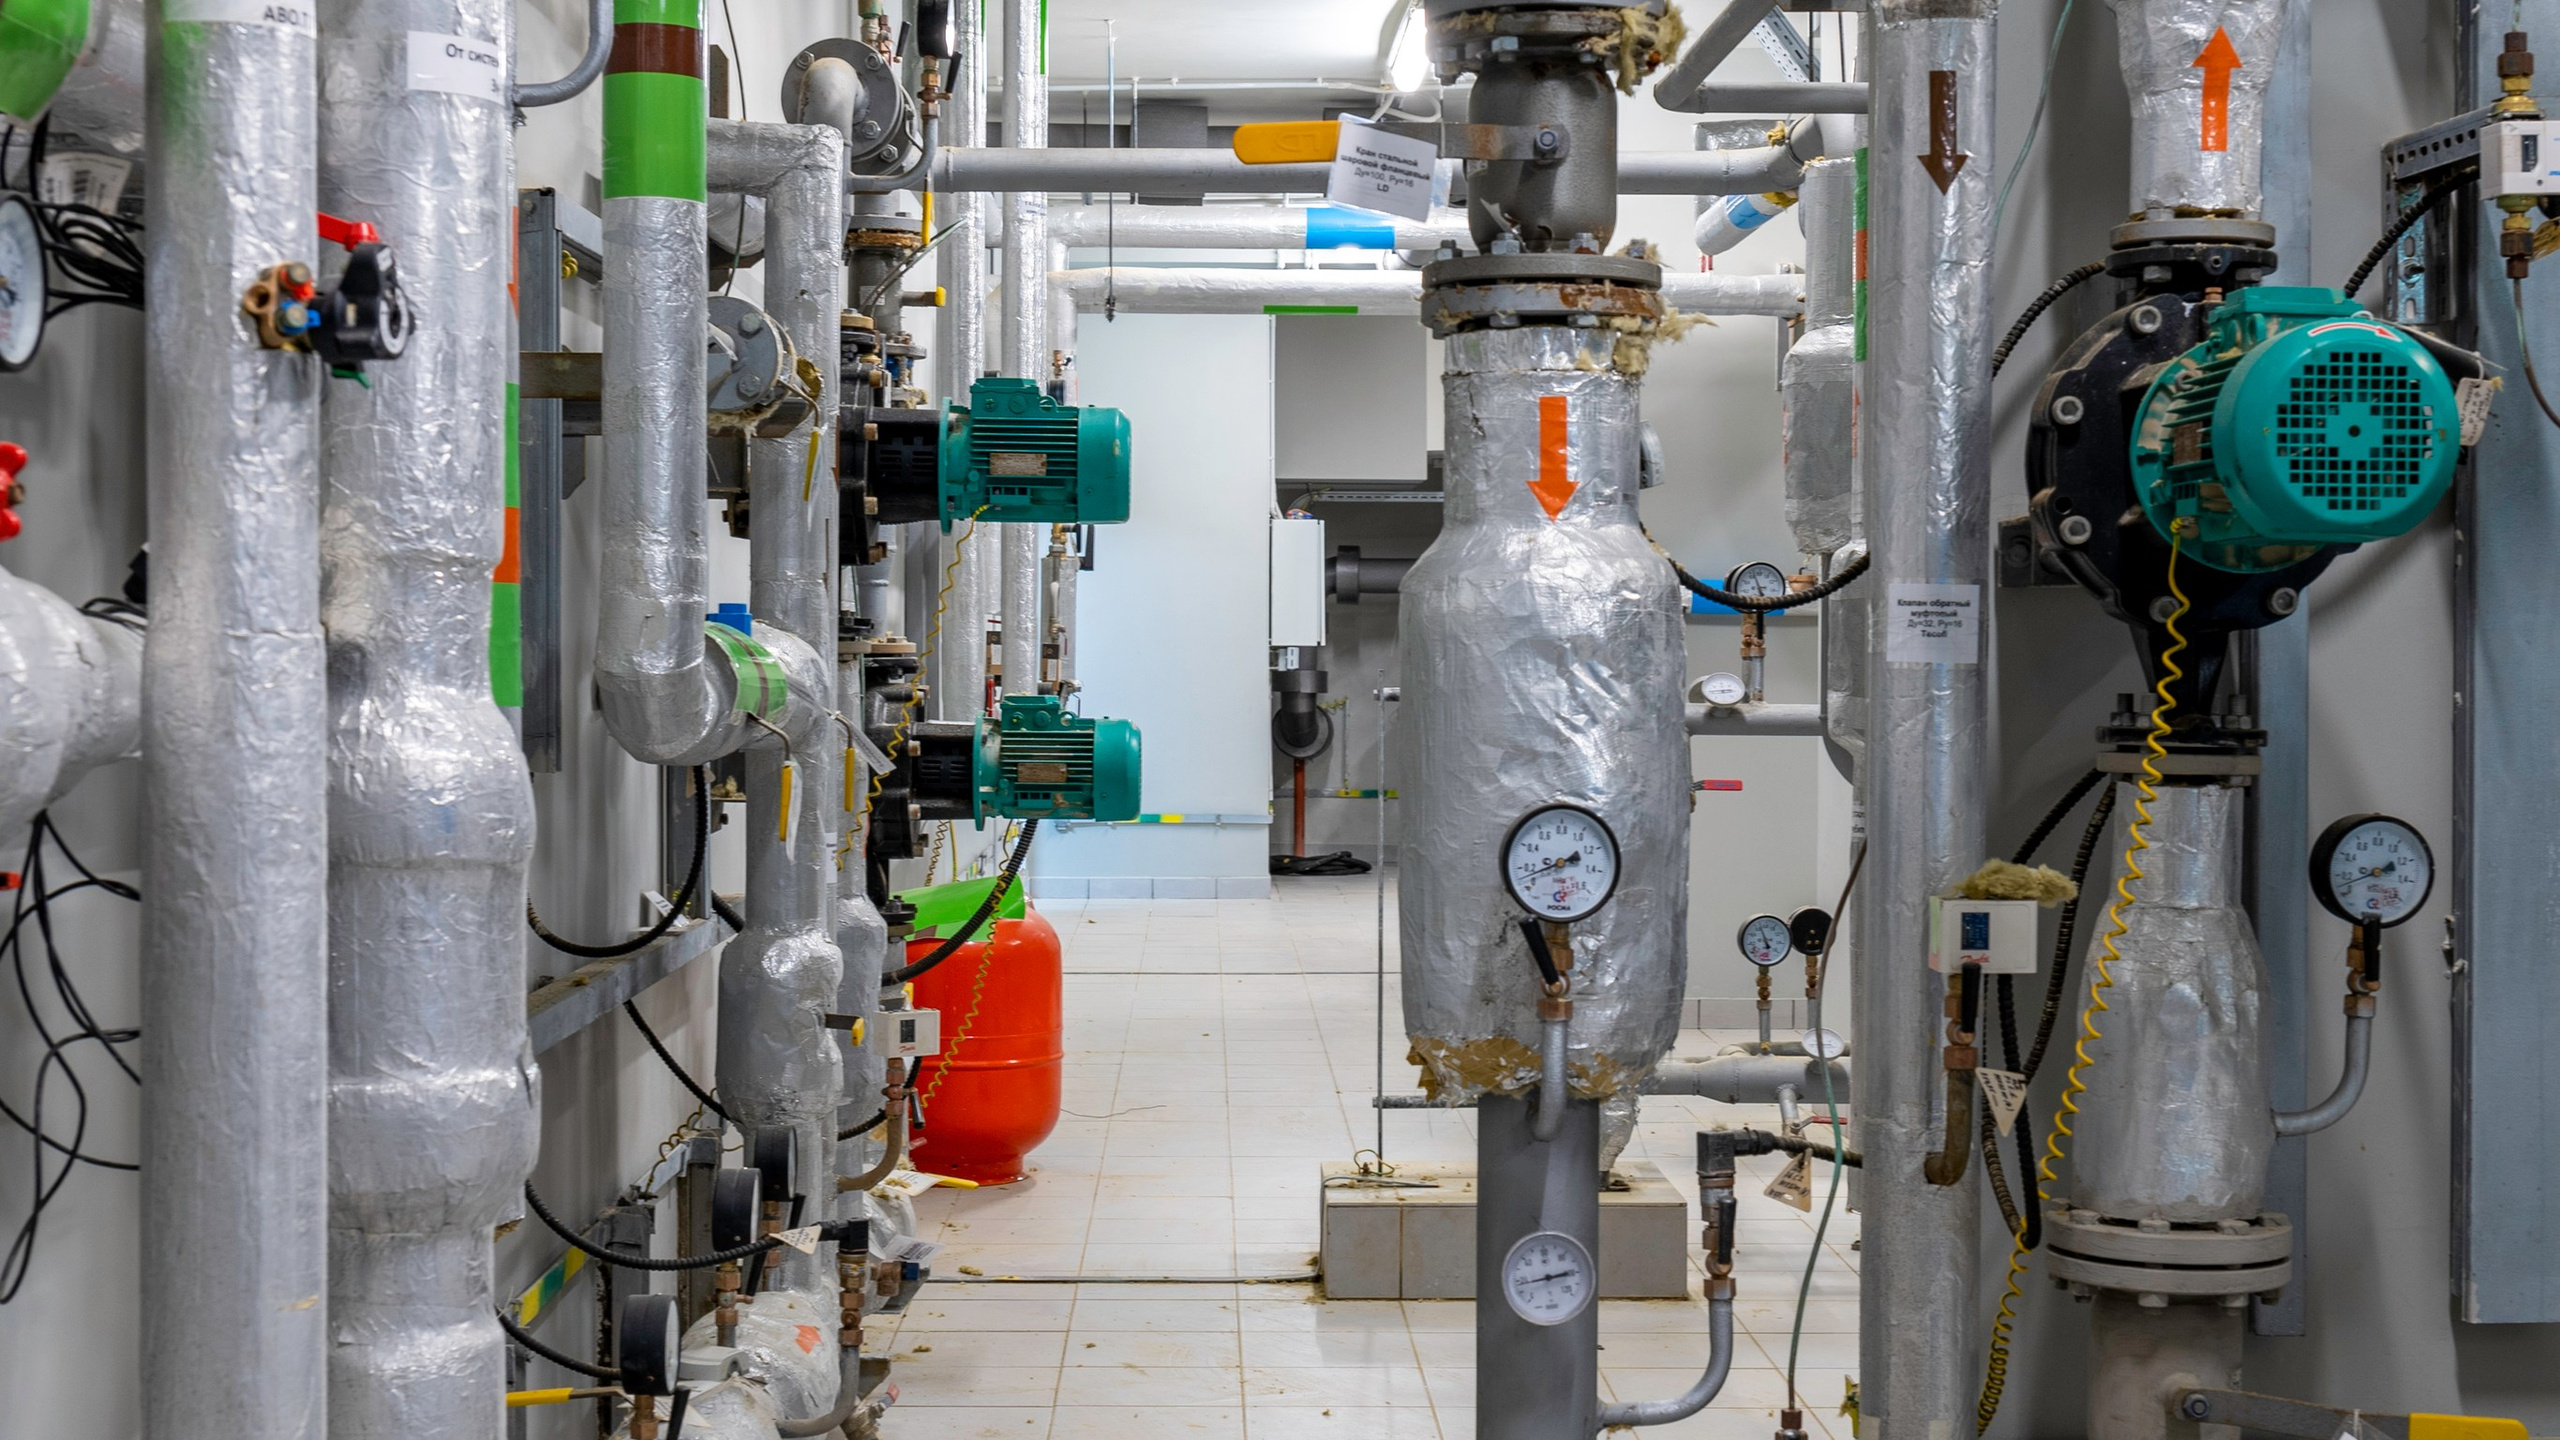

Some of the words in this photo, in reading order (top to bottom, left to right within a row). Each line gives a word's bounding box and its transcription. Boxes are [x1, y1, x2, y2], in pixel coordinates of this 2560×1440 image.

[446, 43, 463, 58] От
[1356, 146, 1376, 157] Кран
[1378, 152, 1418, 167] стальной
[1341, 154, 1378, 168] шаровой
[1380, 163, 1430, 180] фланцевый
[1377, 183, 1390, 192] LD
[1929, 599, 1971, 608] обратный
[1527, 843, 1539, 853] 0,4
[1584, 845, 1595, 854] 1,2
